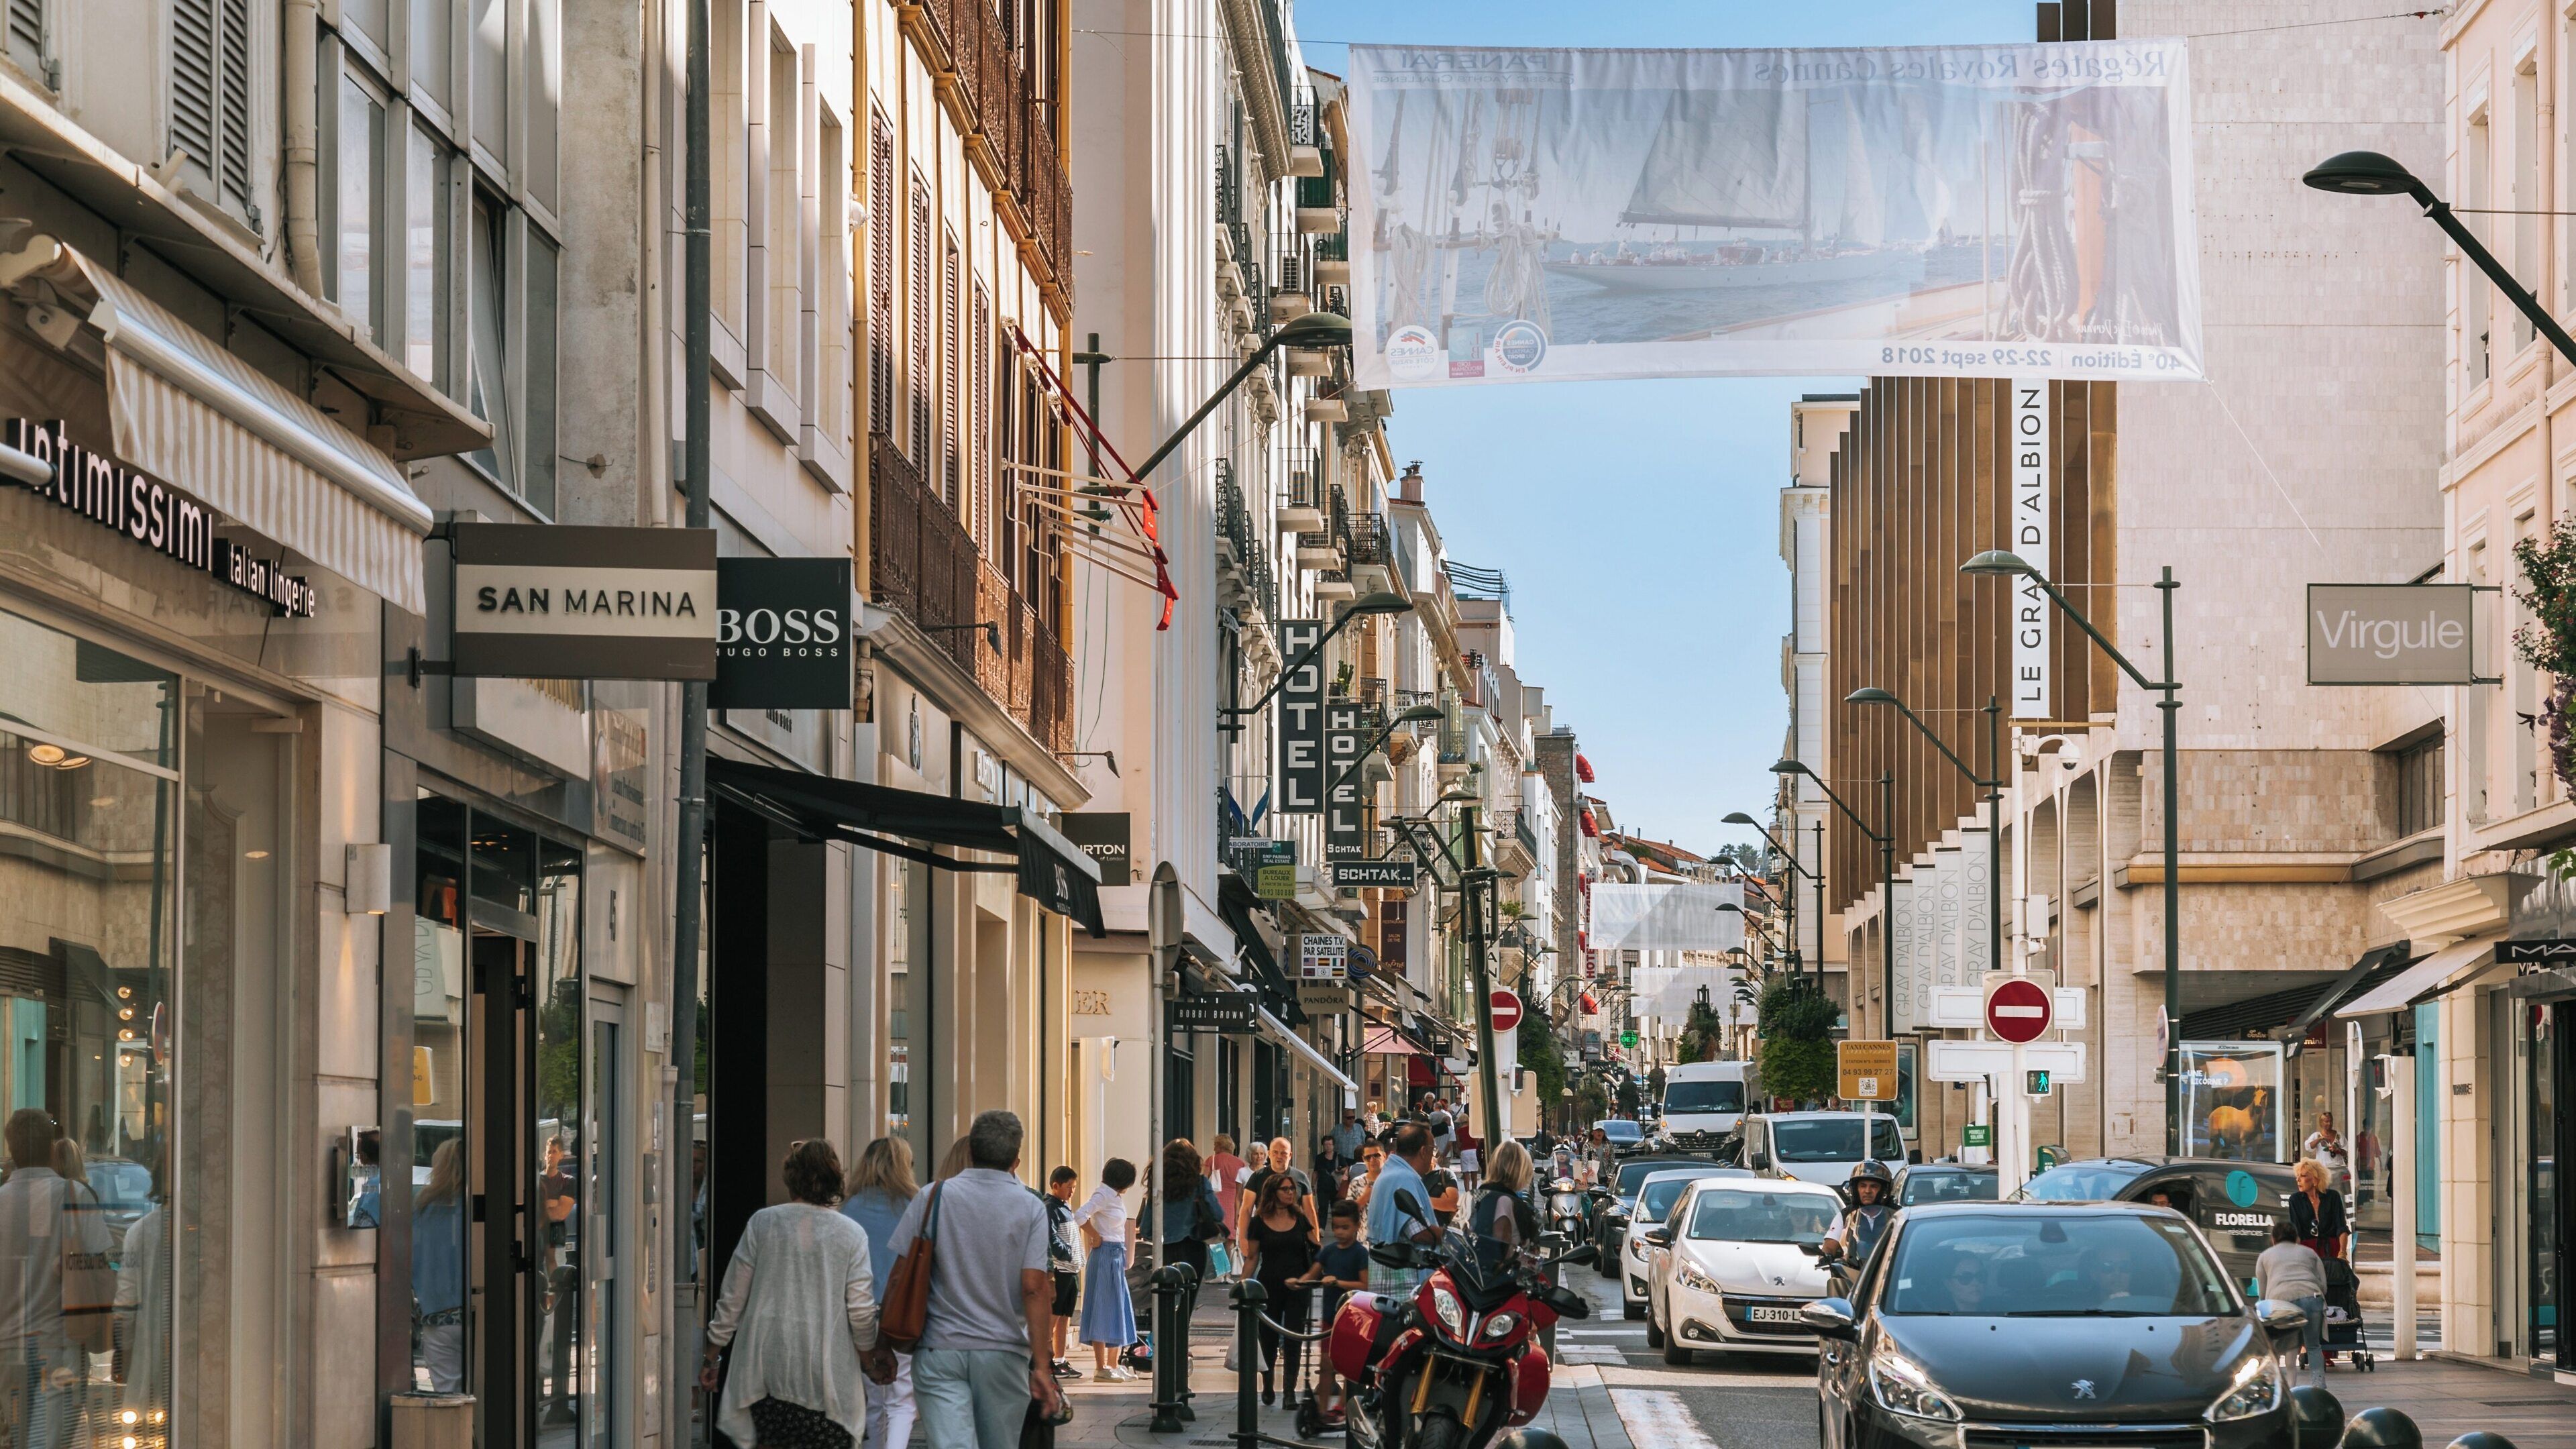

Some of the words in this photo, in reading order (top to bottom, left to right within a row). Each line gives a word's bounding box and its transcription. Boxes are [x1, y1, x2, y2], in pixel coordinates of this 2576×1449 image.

[2021, 388, 2041, 545] D'ALBION
[270, 559, 315, 619] lingerie
[478, 586, 549, 614] SAN
[564, 589, 696, 617] MARINA
[716, 608, 839, 644] BOSS
[2021, 570, 2041, 649] GRA
[2316, 610, 2464, 660] Virgule
[784, 648, 838, 657] BOSS
[2020, 666, 2041, 701] LE
[1285, 627, 1318, 806] HOTEL
[1332, 711, 1356, 831] HOTEL
[1079, 845, 1125, 855] RTON
[1327, 843, 1362, 853] SCHTAK
[1303, 936, 1332, 945] CHAINES
[1334, 936, 1345, 945] T.V.
[1303, 947, 1315, 956] PAR
[1317, 947, 1344, 956] SATELLITE
[1587, 945, 1596, 979] HOTE
[1896, 973, 1910, 1017] GRAY
[1179, 1010, 1207, 1018] BOBBI
[1214, 1010, 1243, 1019] BROWN
[2215, 1213, 2275, 1226] FLORELLA
[2227, 1228, 2263, 1236] résidences
